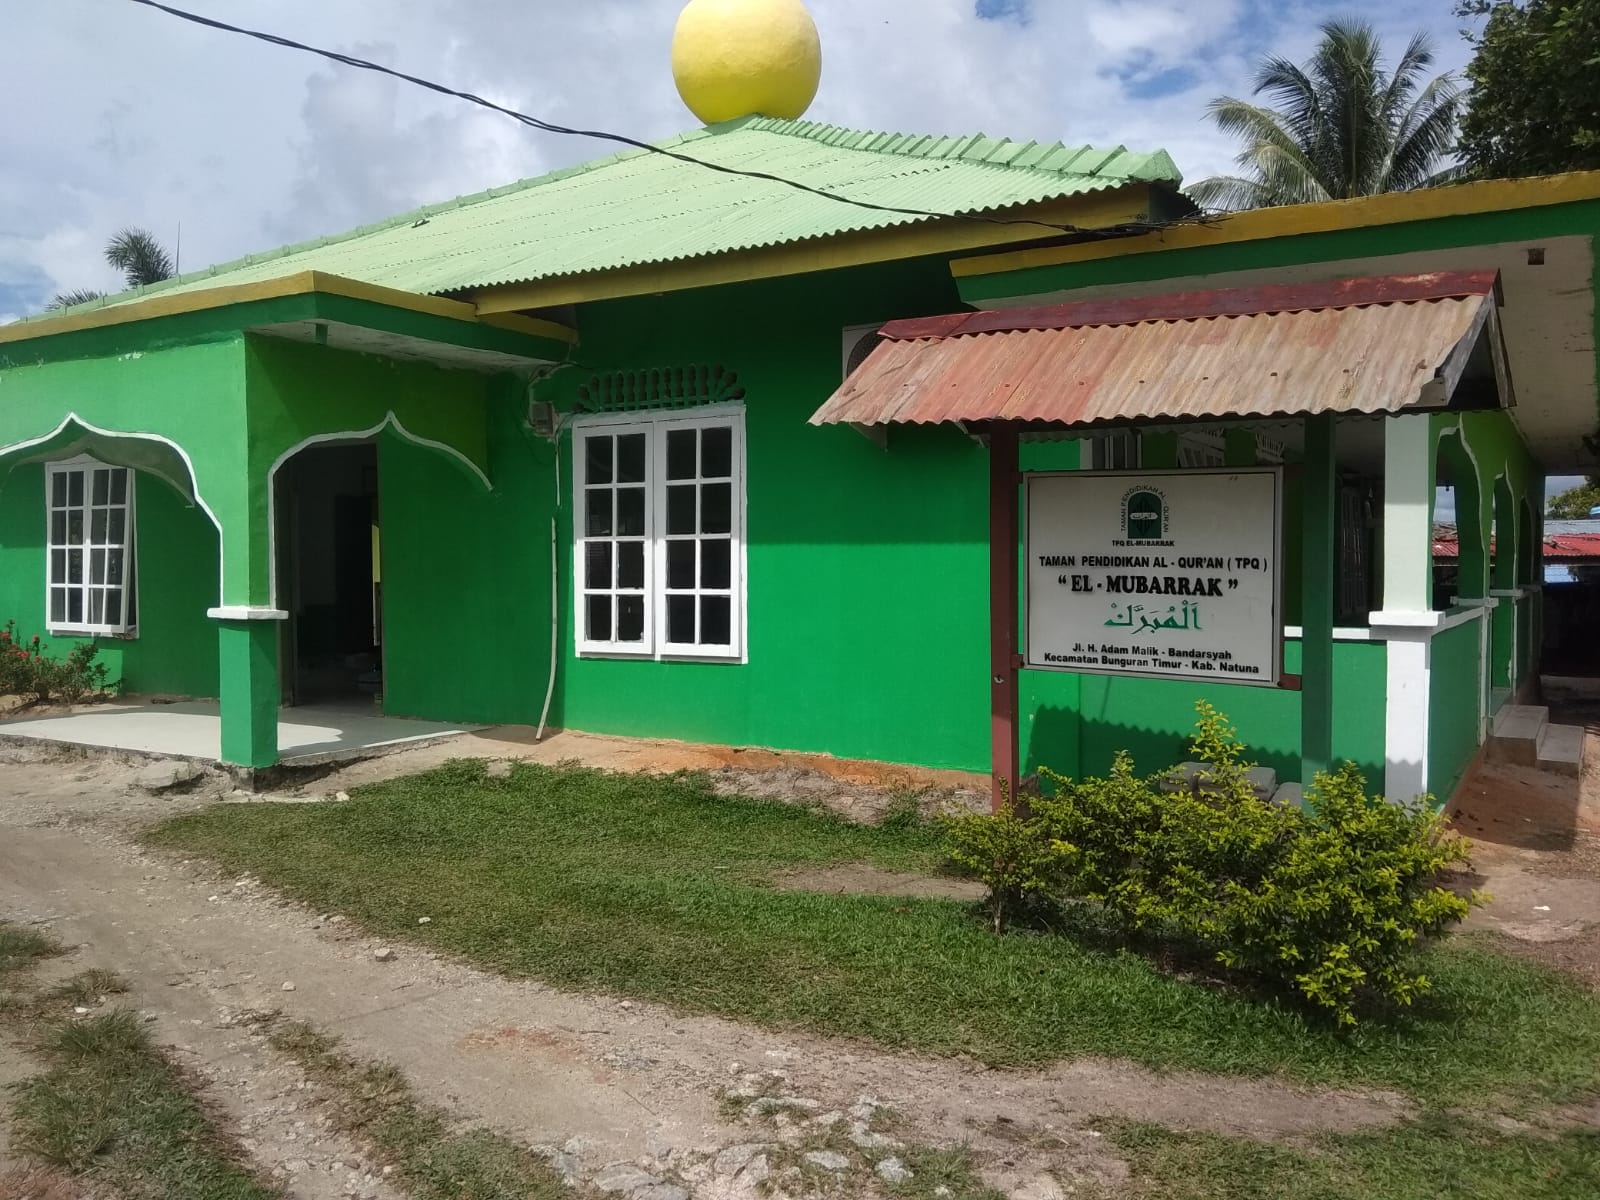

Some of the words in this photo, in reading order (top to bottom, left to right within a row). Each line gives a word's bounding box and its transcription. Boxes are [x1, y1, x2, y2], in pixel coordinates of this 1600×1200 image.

[1038, 555, 1075, 567] TAMAN
[1081, 555, 1149, 567] PENDIDIKAN
[1177, 556, 1223, 568] QUR'AN
[1105, 575, 1223, 597] MUBARRAK
[1072, 643, 1085, 652] Jl.
[1087, 644, 1098, 652] H.
[1100, 644, 1129, 654] Adam
[1131, 646, 1159, 656] Malik
[1168, 648, 1232, 660] Bandarsyah
[1044, 652, 1099, 664] Kecamatan
[1101, 655, 1149, 668] Bunguran
[1151, 658, 1182, 669] Timur
[1191, 660, 1216, 671] Kab.
[1219, 661, 1259, 673] Natuna
